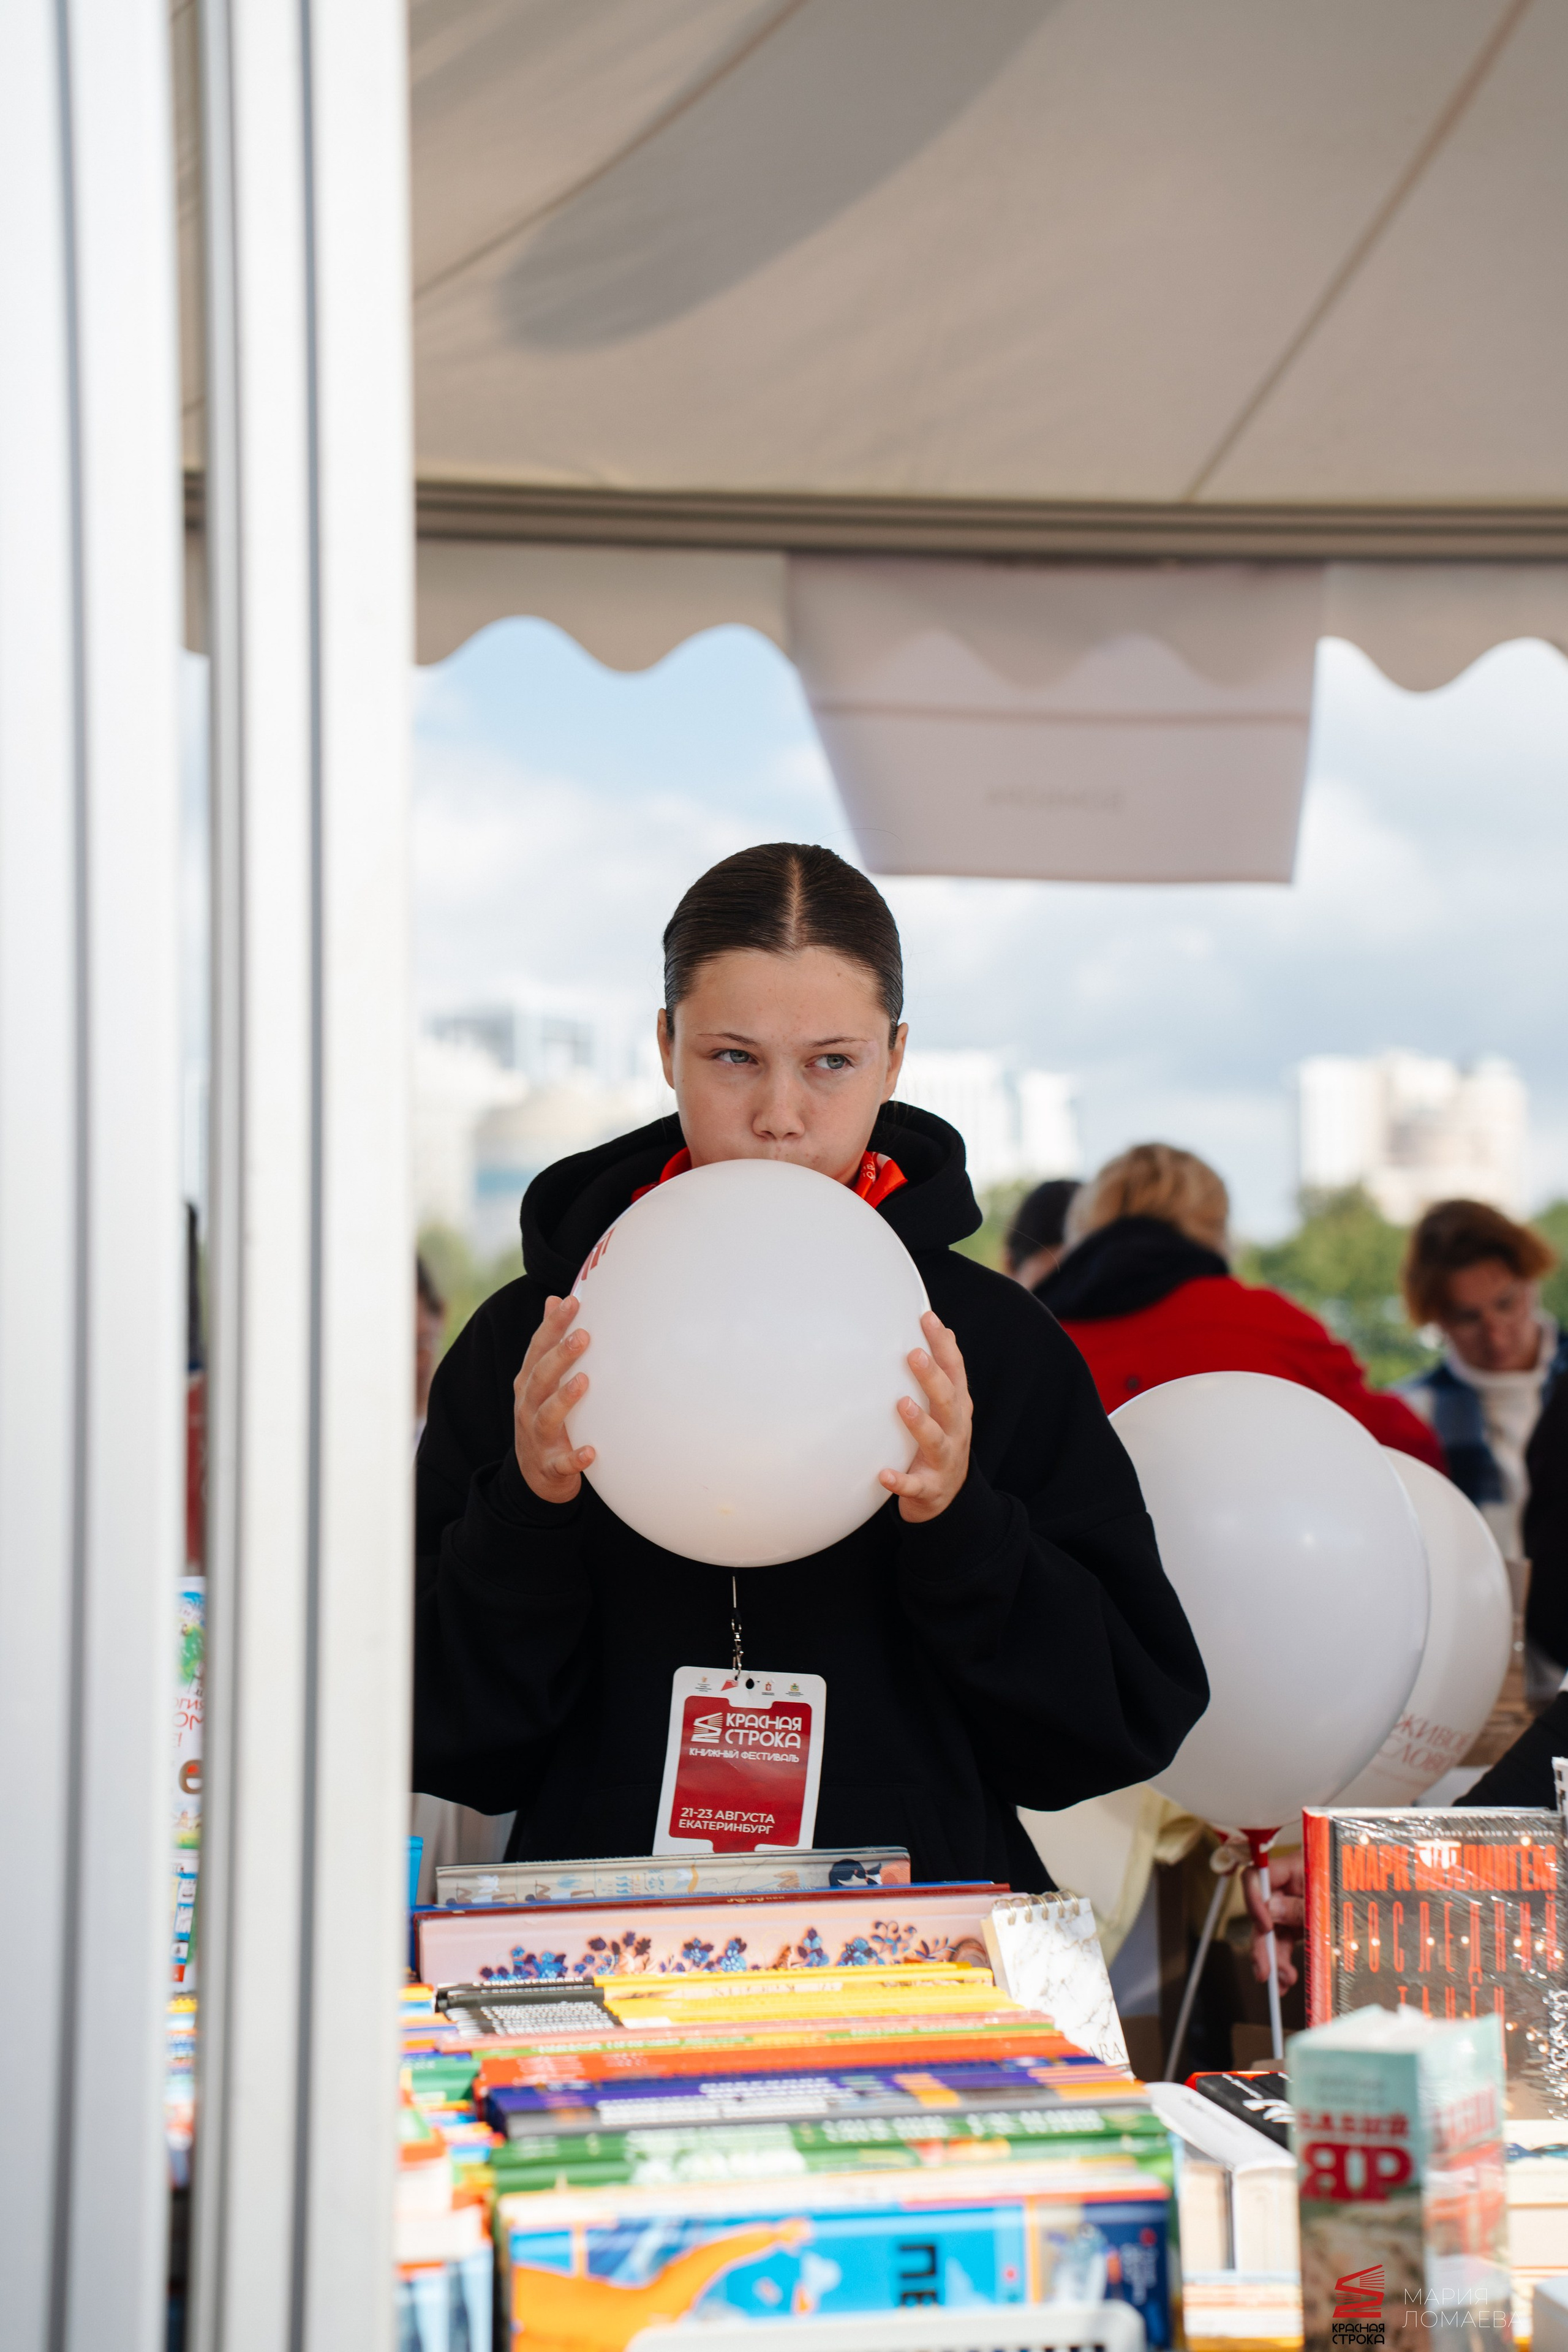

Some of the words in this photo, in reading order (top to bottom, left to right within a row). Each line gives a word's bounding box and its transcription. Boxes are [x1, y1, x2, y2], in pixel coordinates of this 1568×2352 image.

[726, 1713, 802, 1732] КРАСНАЯ
[725, 1728, 801, 1749] СТРОКА
[689, 1747, 739, 1759] КНИЖНЫЙ
[741, 1751, 800, 1763] ФЕСТИВАЛЬ
[680, 1807, 713, 1819] 21-23
[714, 1810, 775, 1824] АВГУСТА
[679, 1819, 774, 1834] ЕКАТЕРИНБУРГ
[1341, 1845, 1411, 1891] МАРК
[1343, 1891, 1558, 1984] ПОСЛЕДНИЙ
[1300, 2141, 1412, 2200] ЯР
